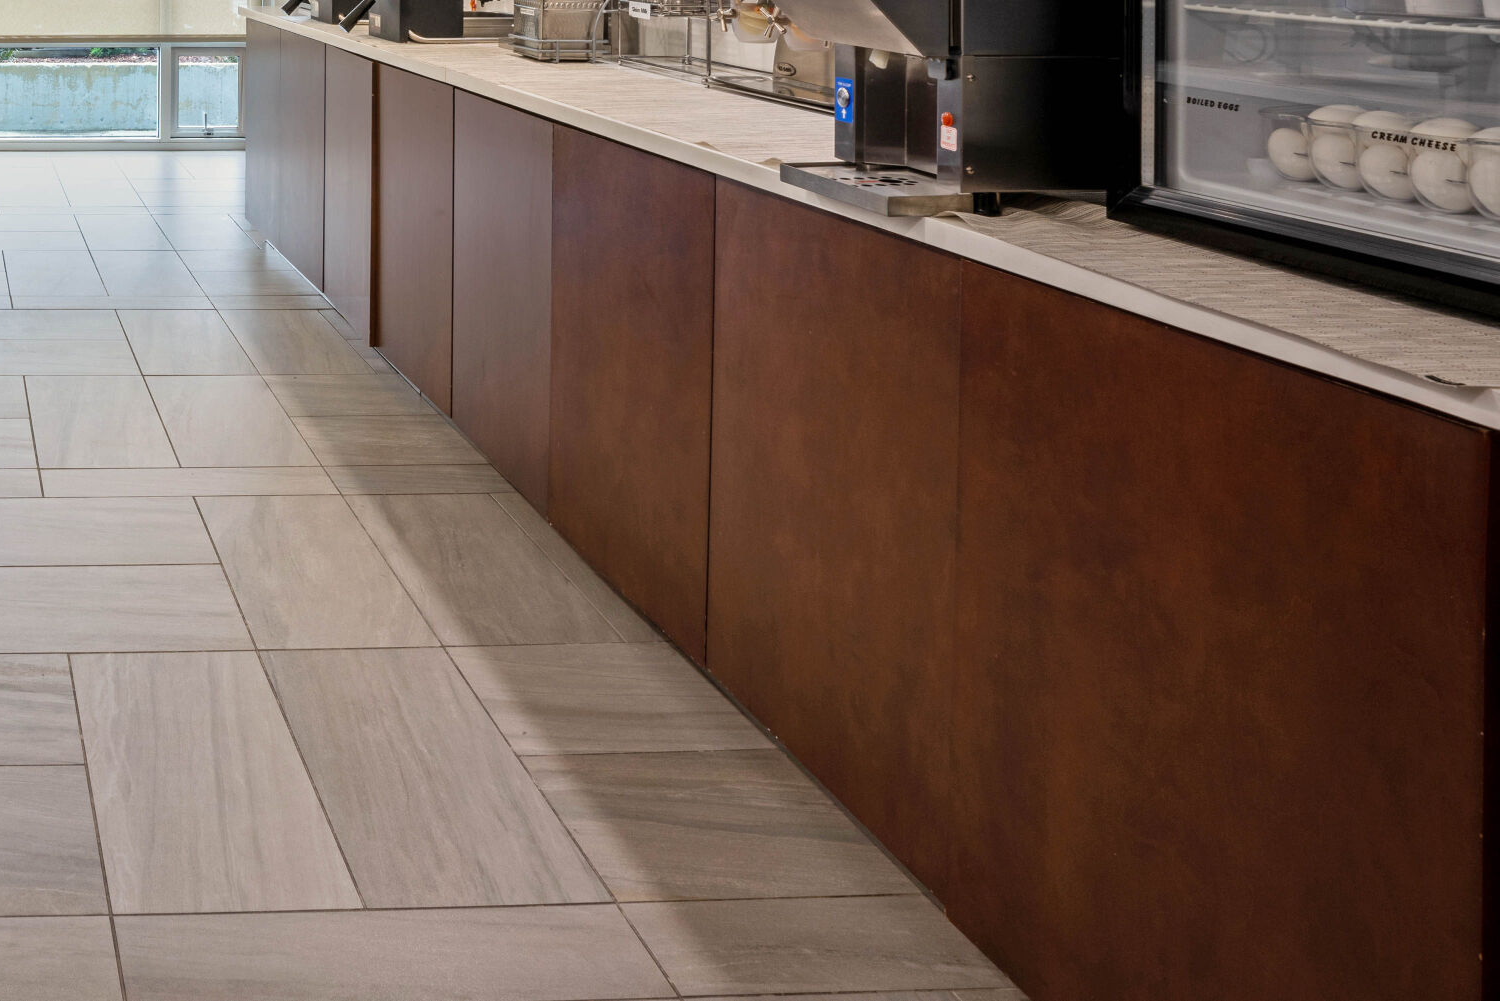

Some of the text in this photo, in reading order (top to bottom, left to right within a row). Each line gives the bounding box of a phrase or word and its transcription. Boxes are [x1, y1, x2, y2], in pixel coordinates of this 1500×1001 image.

[1186, 96, 1240, 112] BOILED EGGS
[1371, 130, 1457, 152] CREAM CHEESE
